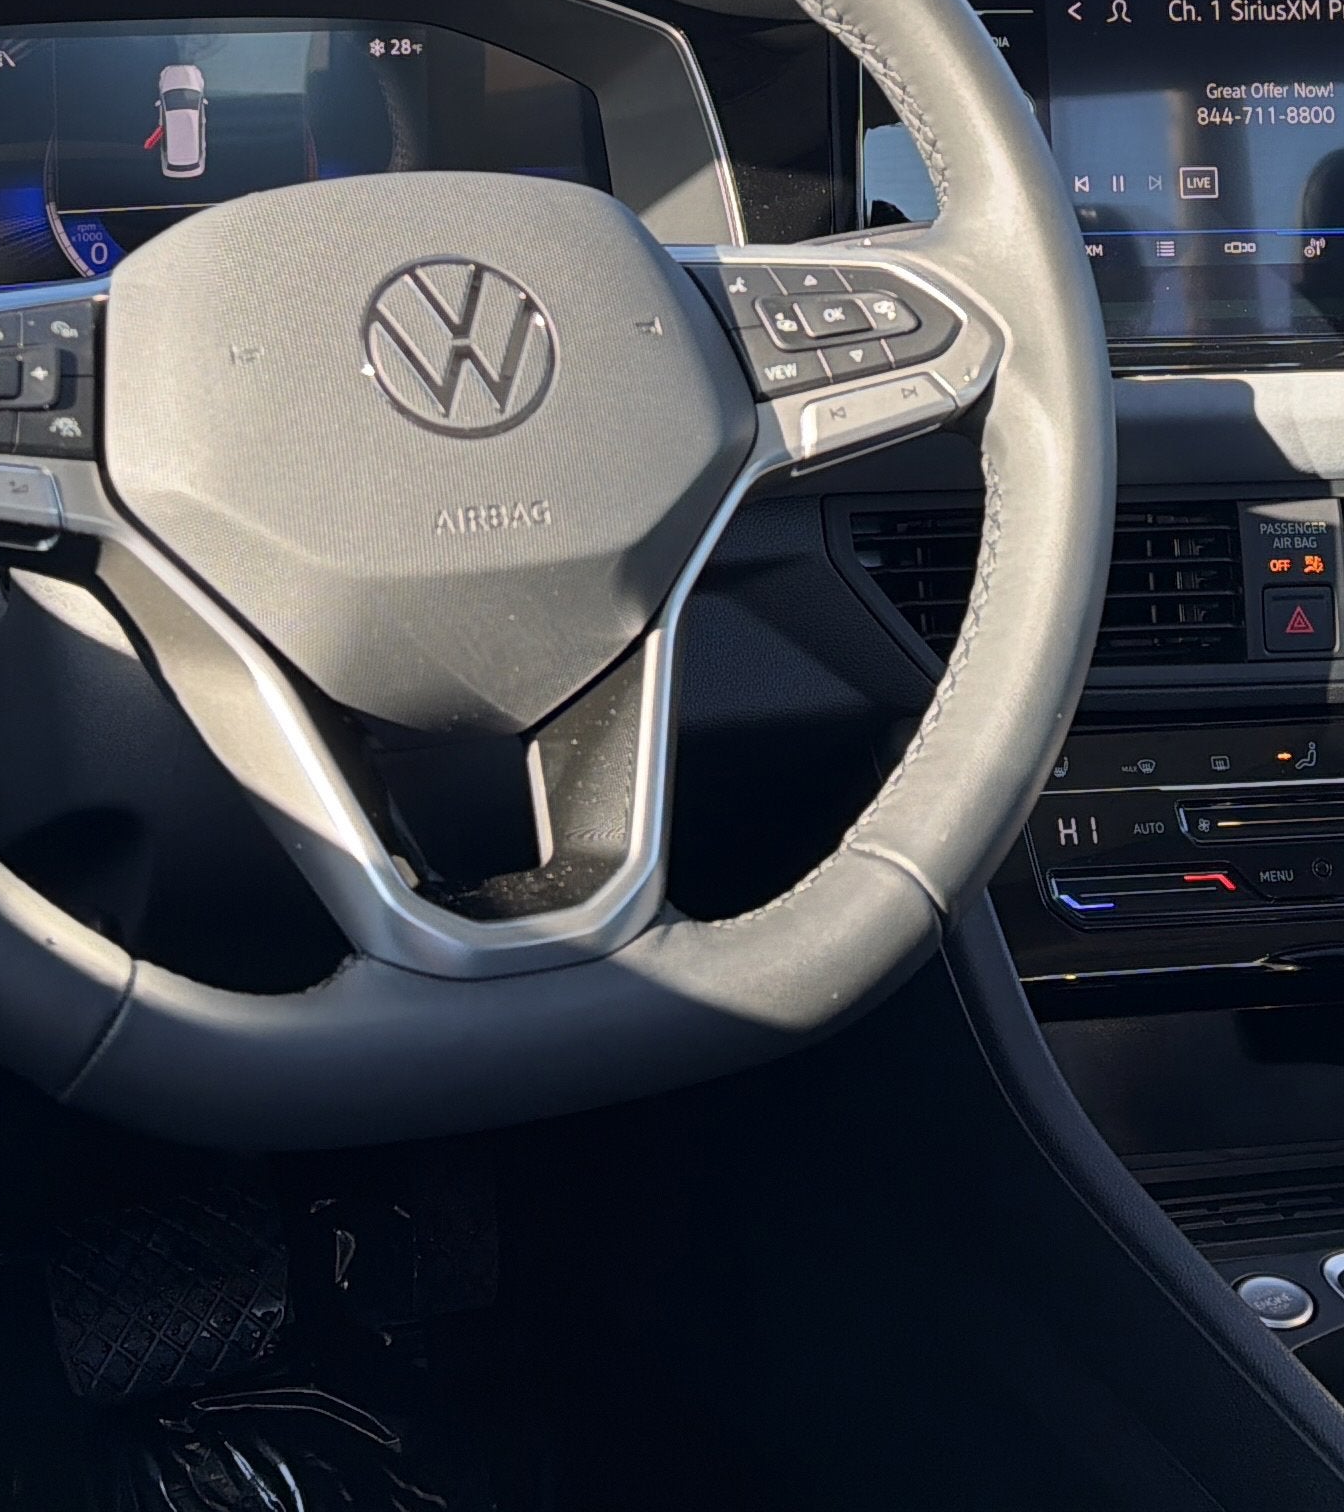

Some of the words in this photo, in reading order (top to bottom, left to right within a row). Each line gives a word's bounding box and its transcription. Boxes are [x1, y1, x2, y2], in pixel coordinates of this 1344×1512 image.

[1168, 0, 1202, 22] Ch.
[1210, 0, 1222, 21] 1
[1230, 0, 1321, 21] SiriusXM
[1206, 83, 1246, 99] Great
[1250, 82, 1289, 99] Offer
[1293, 82, 1335, 98] Now!
[1197, 106, 1336, 126] 844-711-8800
[1186, 176, 1212, 189] LIVE
[77, 223, 97, 233] rpm
[90, 242, 109, 265] 0
[1085, 244, 1104, 257] XM
[822, 306, 846, 323] OK
[763, 362, 798, 381] VIEW
[436, 500, 553, 536] AIRBAG
[1259, 520, 1327, 535] PASSENGER
[1272, 536, 1292, 549] AIR
[1293, 536, 1318, 549] BAG
[1269, 559, 1292, 573] OFF
[1132, 821, 1166, 836] AUTO
[1259, 868, 1295, 883] MENU
